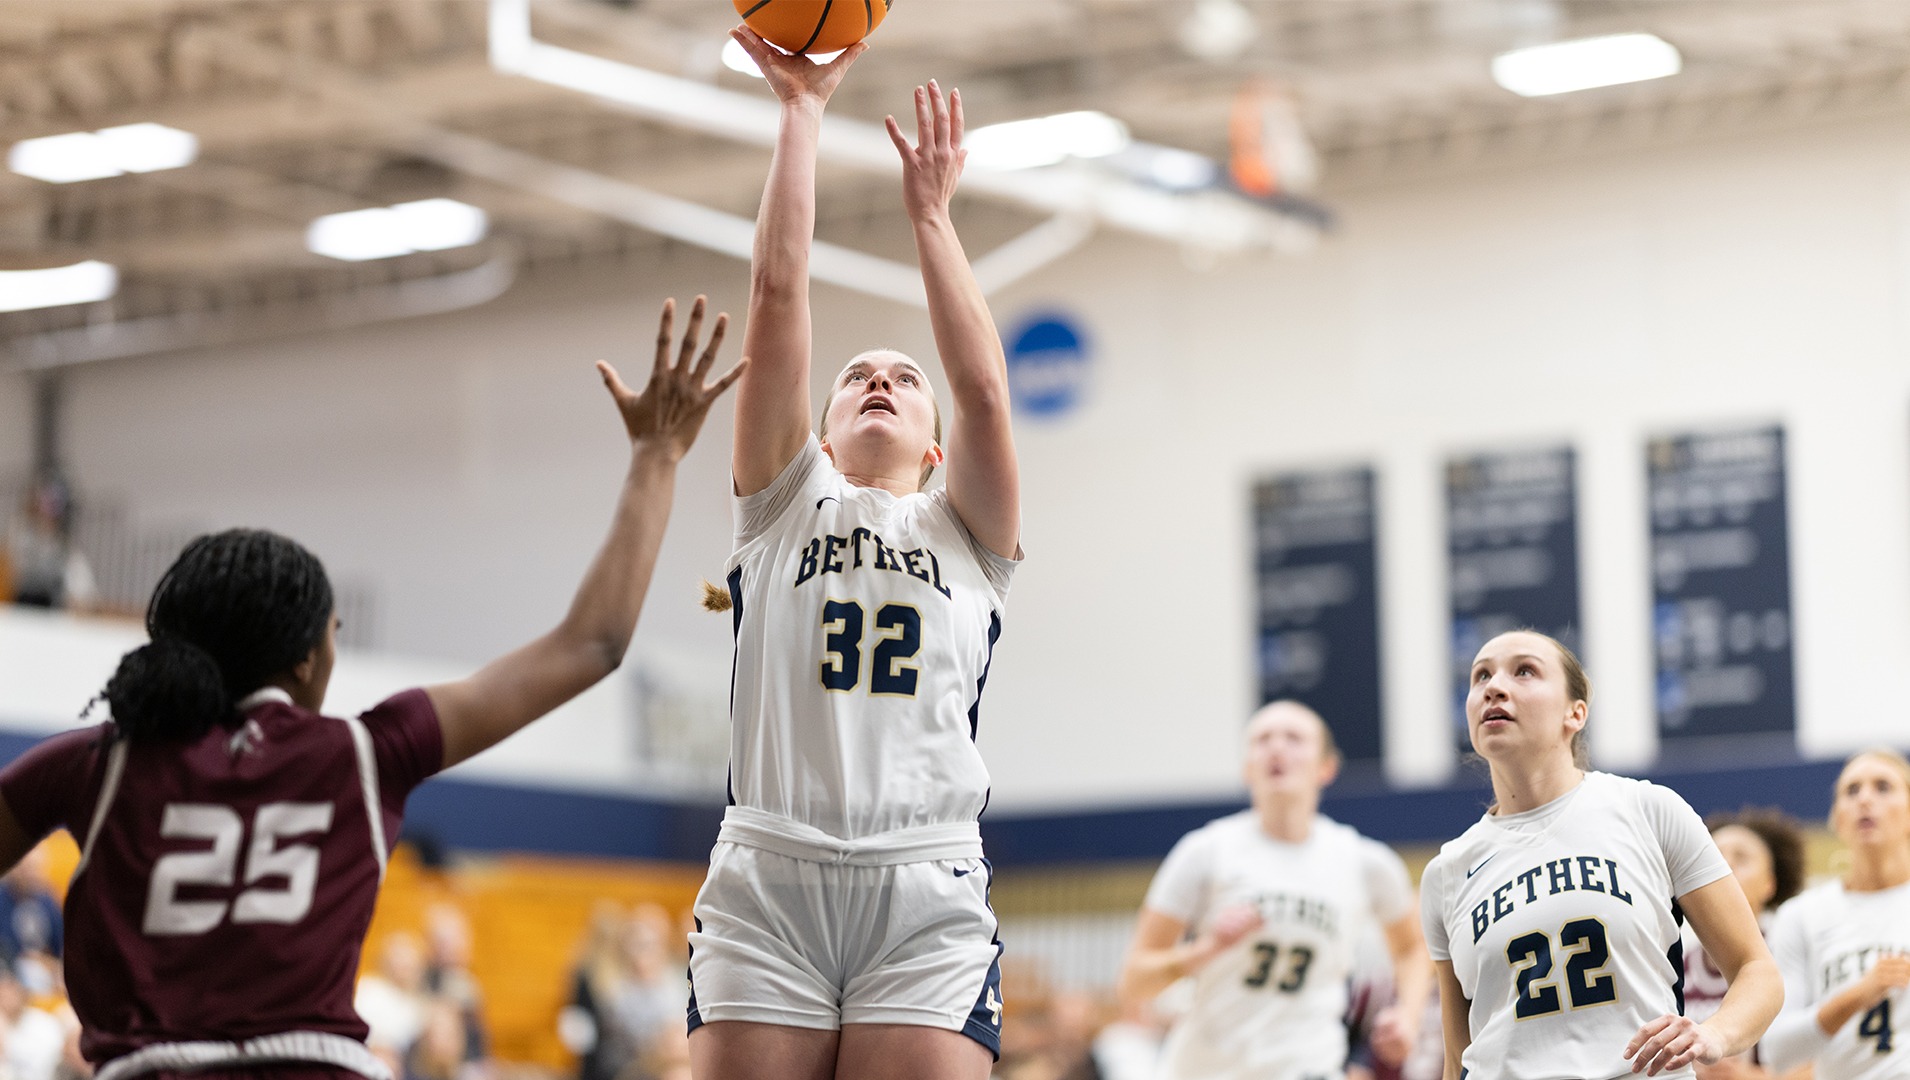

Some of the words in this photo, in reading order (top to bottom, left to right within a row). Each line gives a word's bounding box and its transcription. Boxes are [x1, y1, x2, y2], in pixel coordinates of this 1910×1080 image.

[794, 526, 952, 601] BETHEL
[818, 597, 924, 699] 32
[142, 802, 335, 935] 25
[1470, 855, 1633, 945] BETHEL
[1242, 940, 1316, 995] 33
[1504, 916, 1619, 1022] 22
[1857, 996, 1896, 1055] 4
